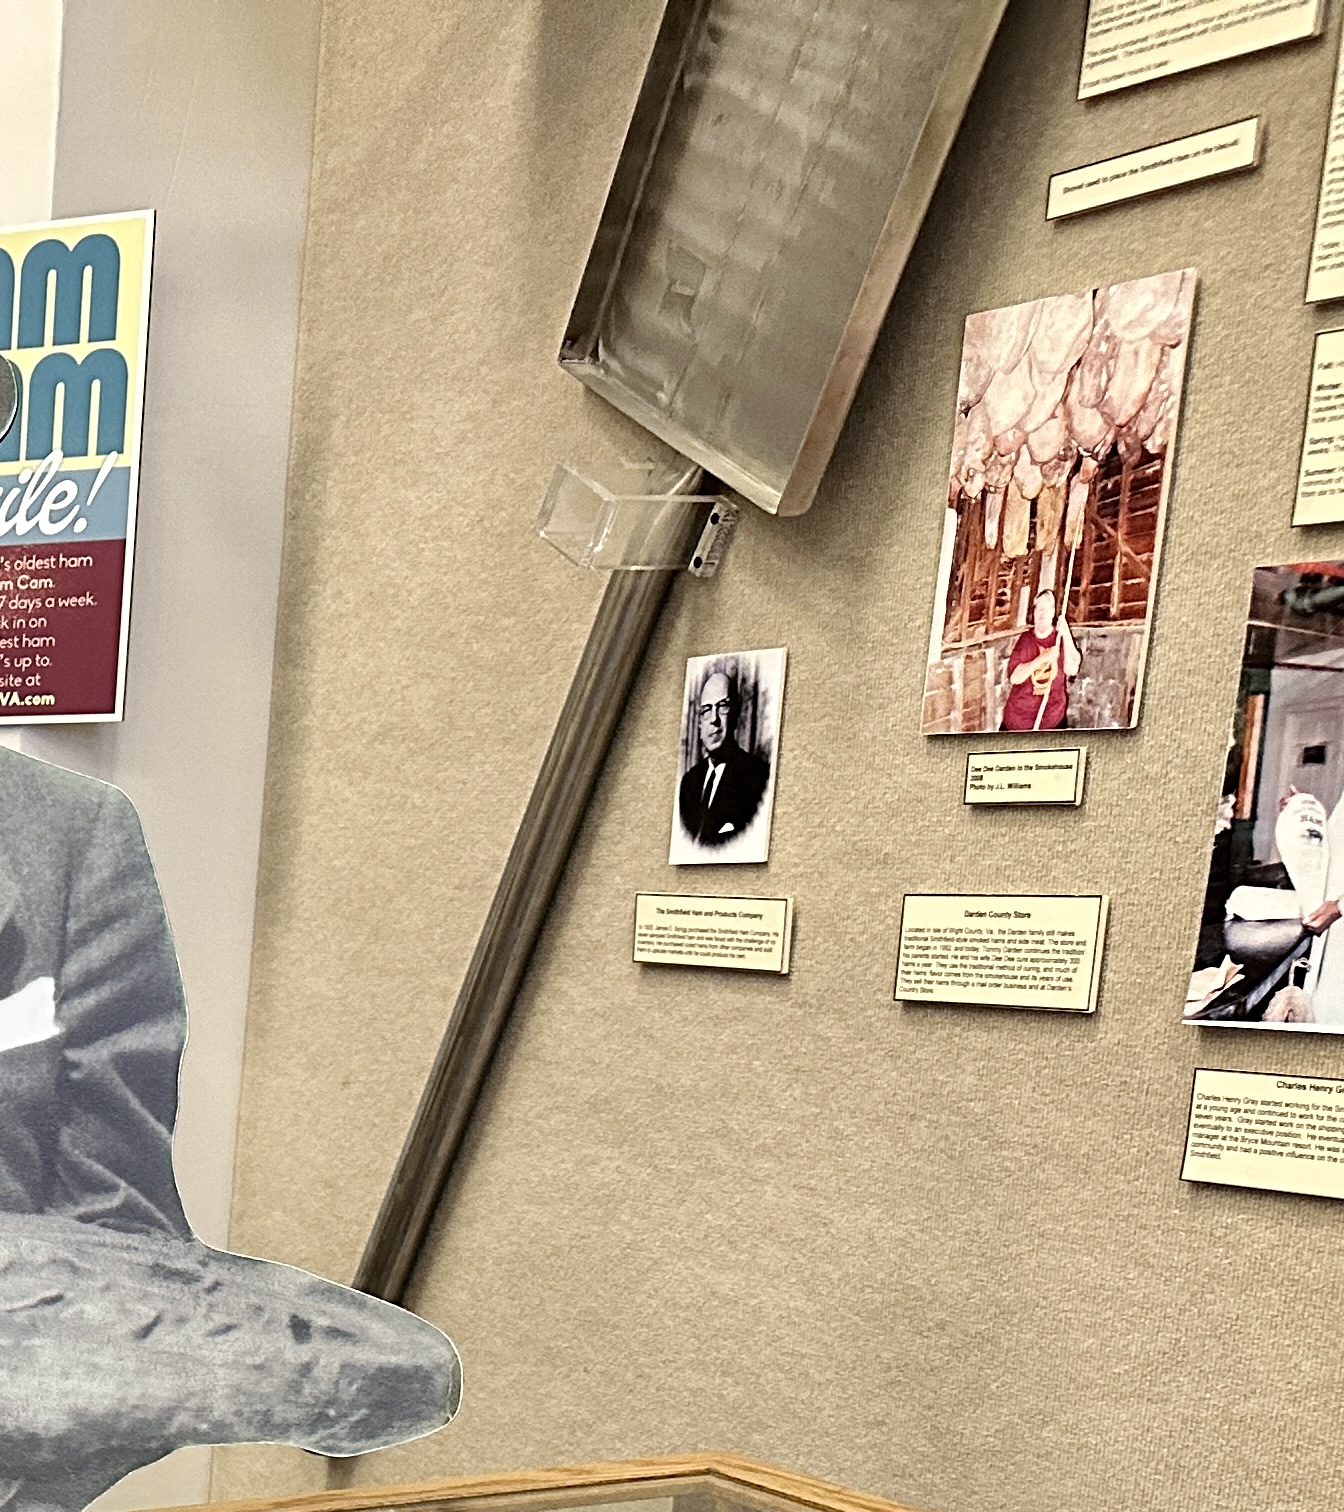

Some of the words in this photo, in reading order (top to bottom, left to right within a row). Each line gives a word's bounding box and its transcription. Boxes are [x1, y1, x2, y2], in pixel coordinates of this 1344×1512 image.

[14, 555, 55, 570] oldest
[60, 554, 92, 567] ham
[18, 575, 55, 589] Cam.
[9, 596, 41, 613] days
[45, 598, 54, 607] a
[59, 592, 97, 607] week.
[13, 616, 25, 628] in
[29, 618, 47, 628] on
[23, 634, 55, 647] ham
[14, 656, 31, 671] up
[35, 654, 52, 666] to.
[25, 674, 41, 686] at
[1276, 1080, 1306, 1090] Charles
[1309, 1083, 1333, 1094] Henry
